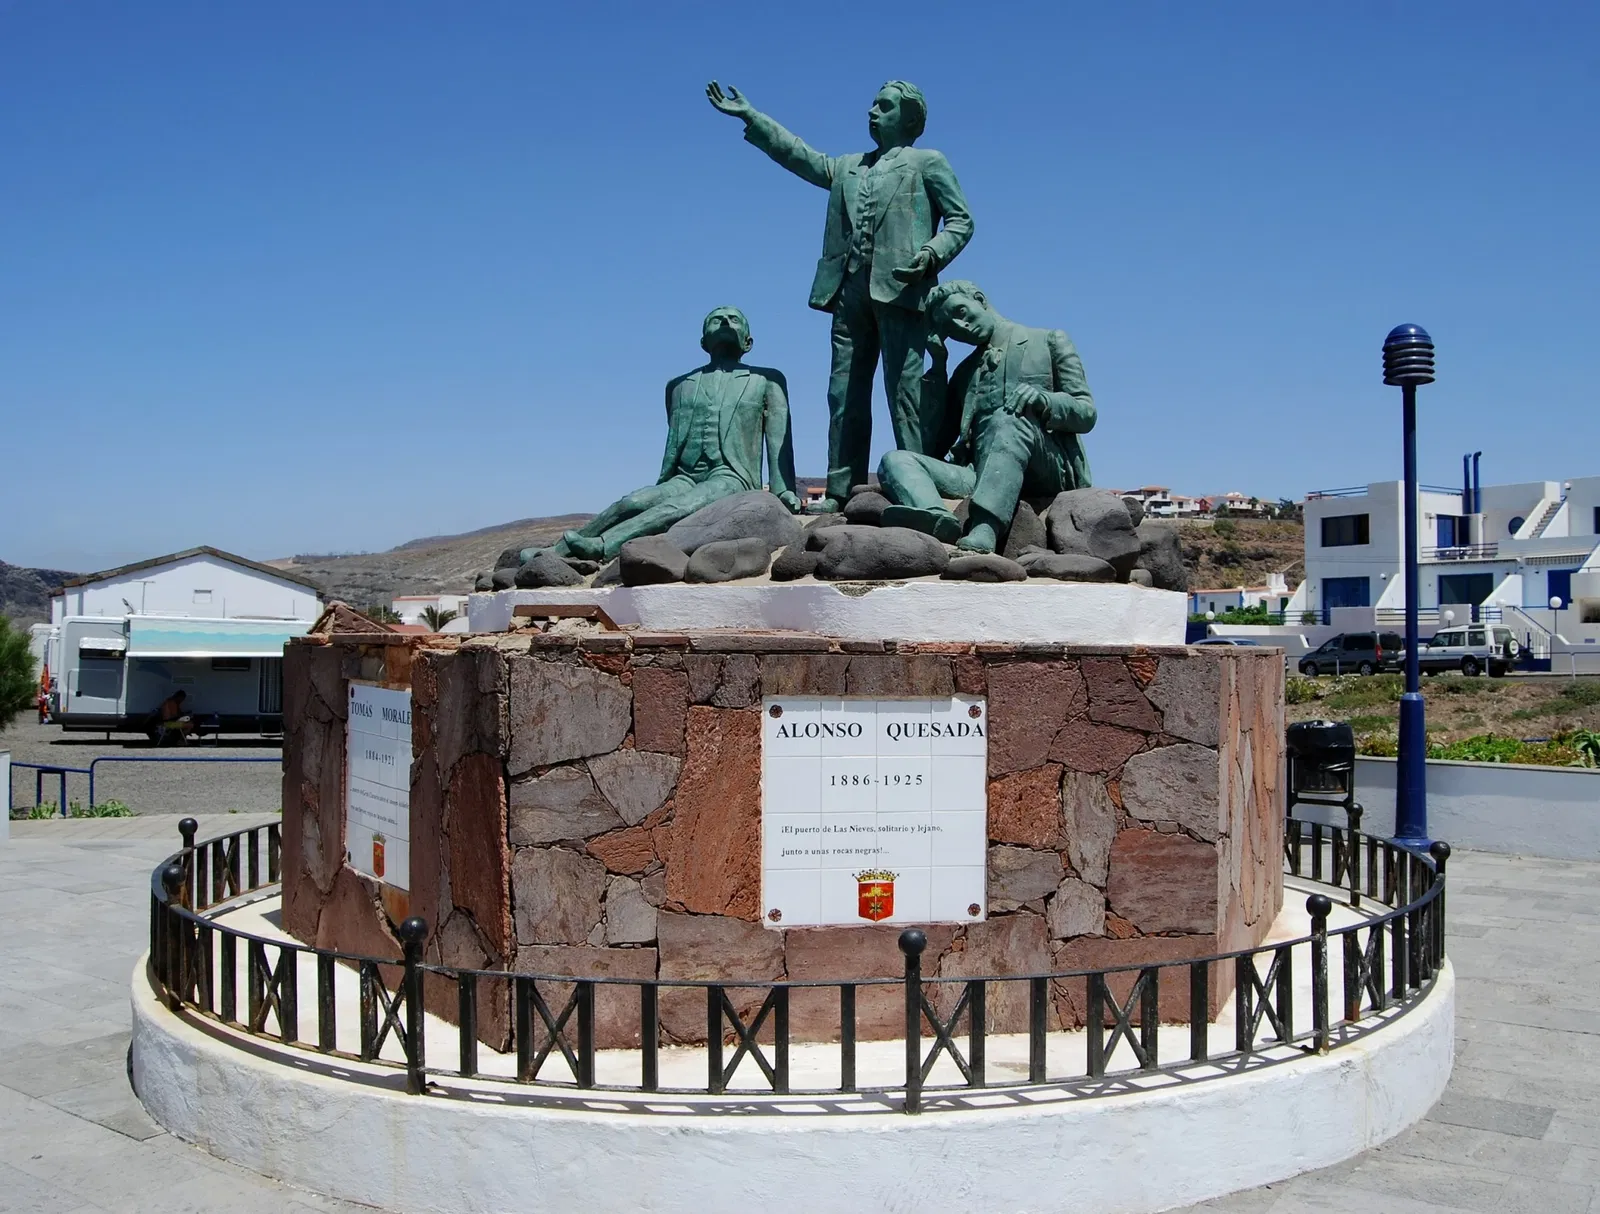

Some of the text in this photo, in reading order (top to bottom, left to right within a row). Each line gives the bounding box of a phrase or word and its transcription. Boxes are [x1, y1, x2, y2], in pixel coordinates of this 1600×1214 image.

[776, 722, 984, 741] ALONSO QUESADA
[830, 774, 923, 786] 1886-1925
[794, 827, 820, 835] puerto
[822, 825, 832, 833] de
[833, 825, 847, 833] Las
[849, 825, 876, 833] Nieves,
[878, 824, 909, 833] solitario
[910, 826, 916, 834] y
[917, 824, 943, 834] lejano,
[781, 848, 803, 858] junto
[832, 847, 853, 855] rocas
